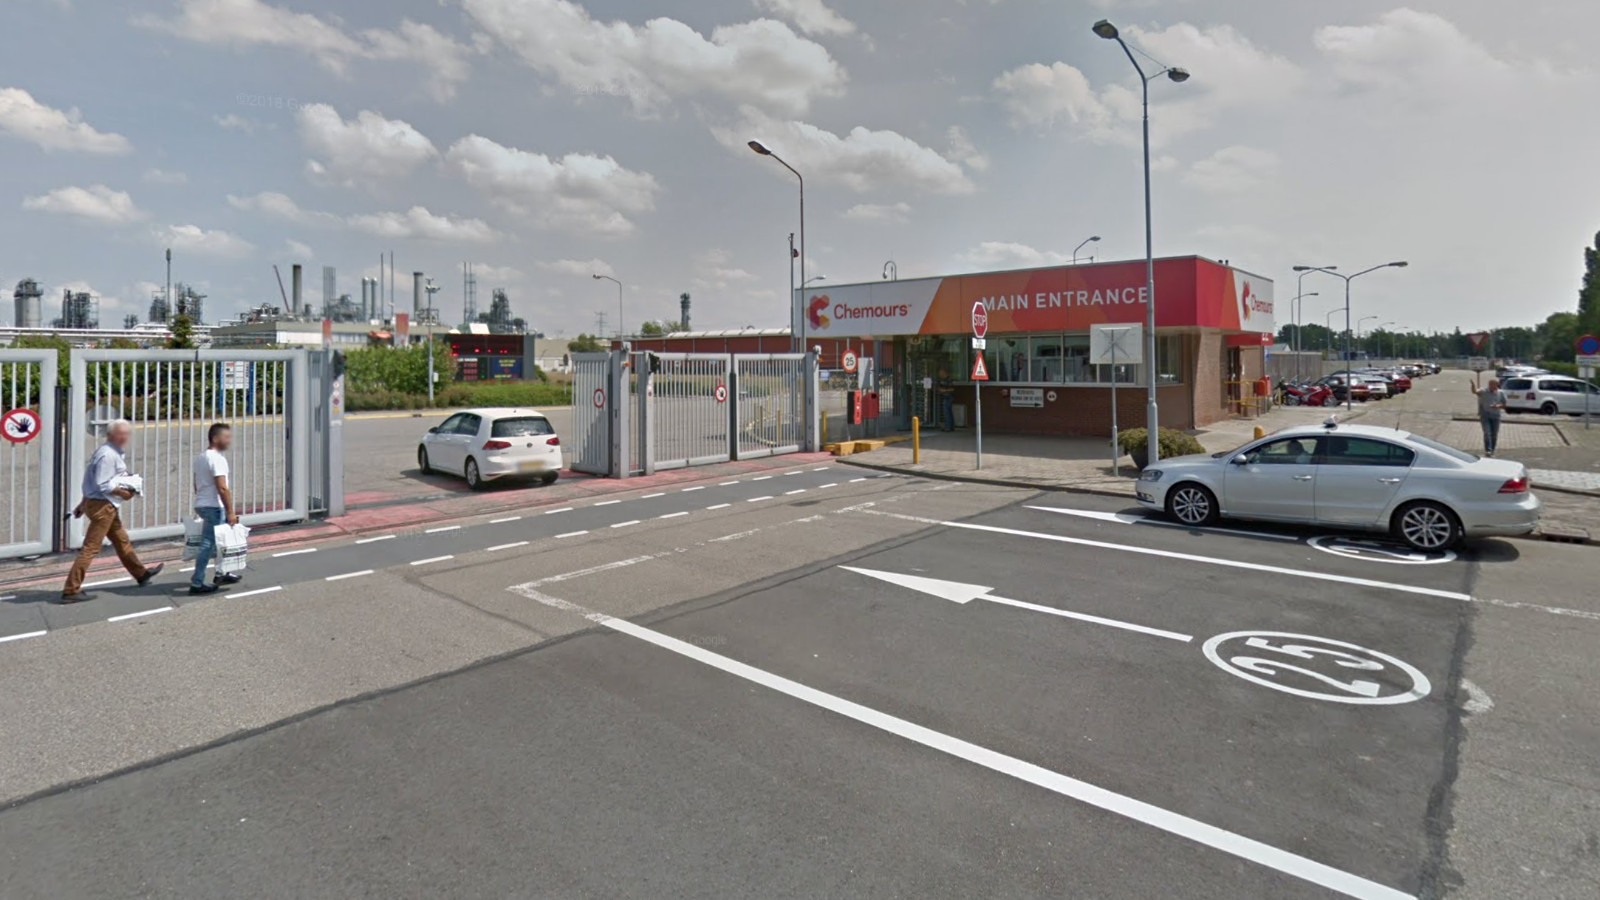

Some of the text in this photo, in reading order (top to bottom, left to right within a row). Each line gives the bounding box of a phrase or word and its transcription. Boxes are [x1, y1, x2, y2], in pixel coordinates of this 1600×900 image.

[982, 287, 1148, 311] MAIN ENTRANCE
[833, 303, 908, 320] Chemours
[974, 313, 987, 327] STOP
[845, 356, 855, 367] 25
[1230, 636, 1384, 698] 25
